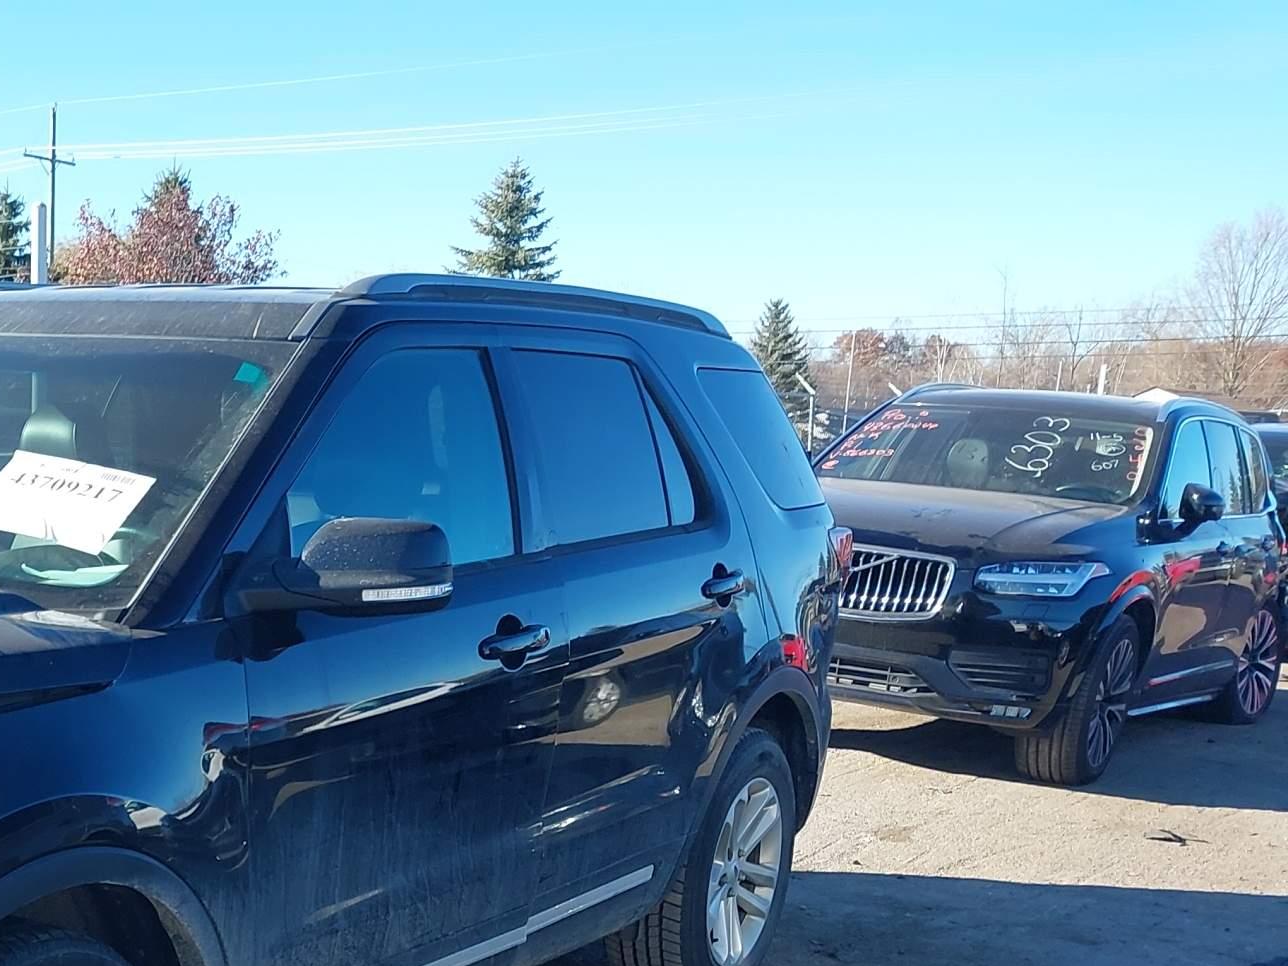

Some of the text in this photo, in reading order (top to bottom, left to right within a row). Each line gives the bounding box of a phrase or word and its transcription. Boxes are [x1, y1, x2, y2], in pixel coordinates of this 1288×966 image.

[1005, 416, 1070, 478] 6303
[1091, 459, 1119, 471] 607
[11, 472, 123, 502] 43709217
